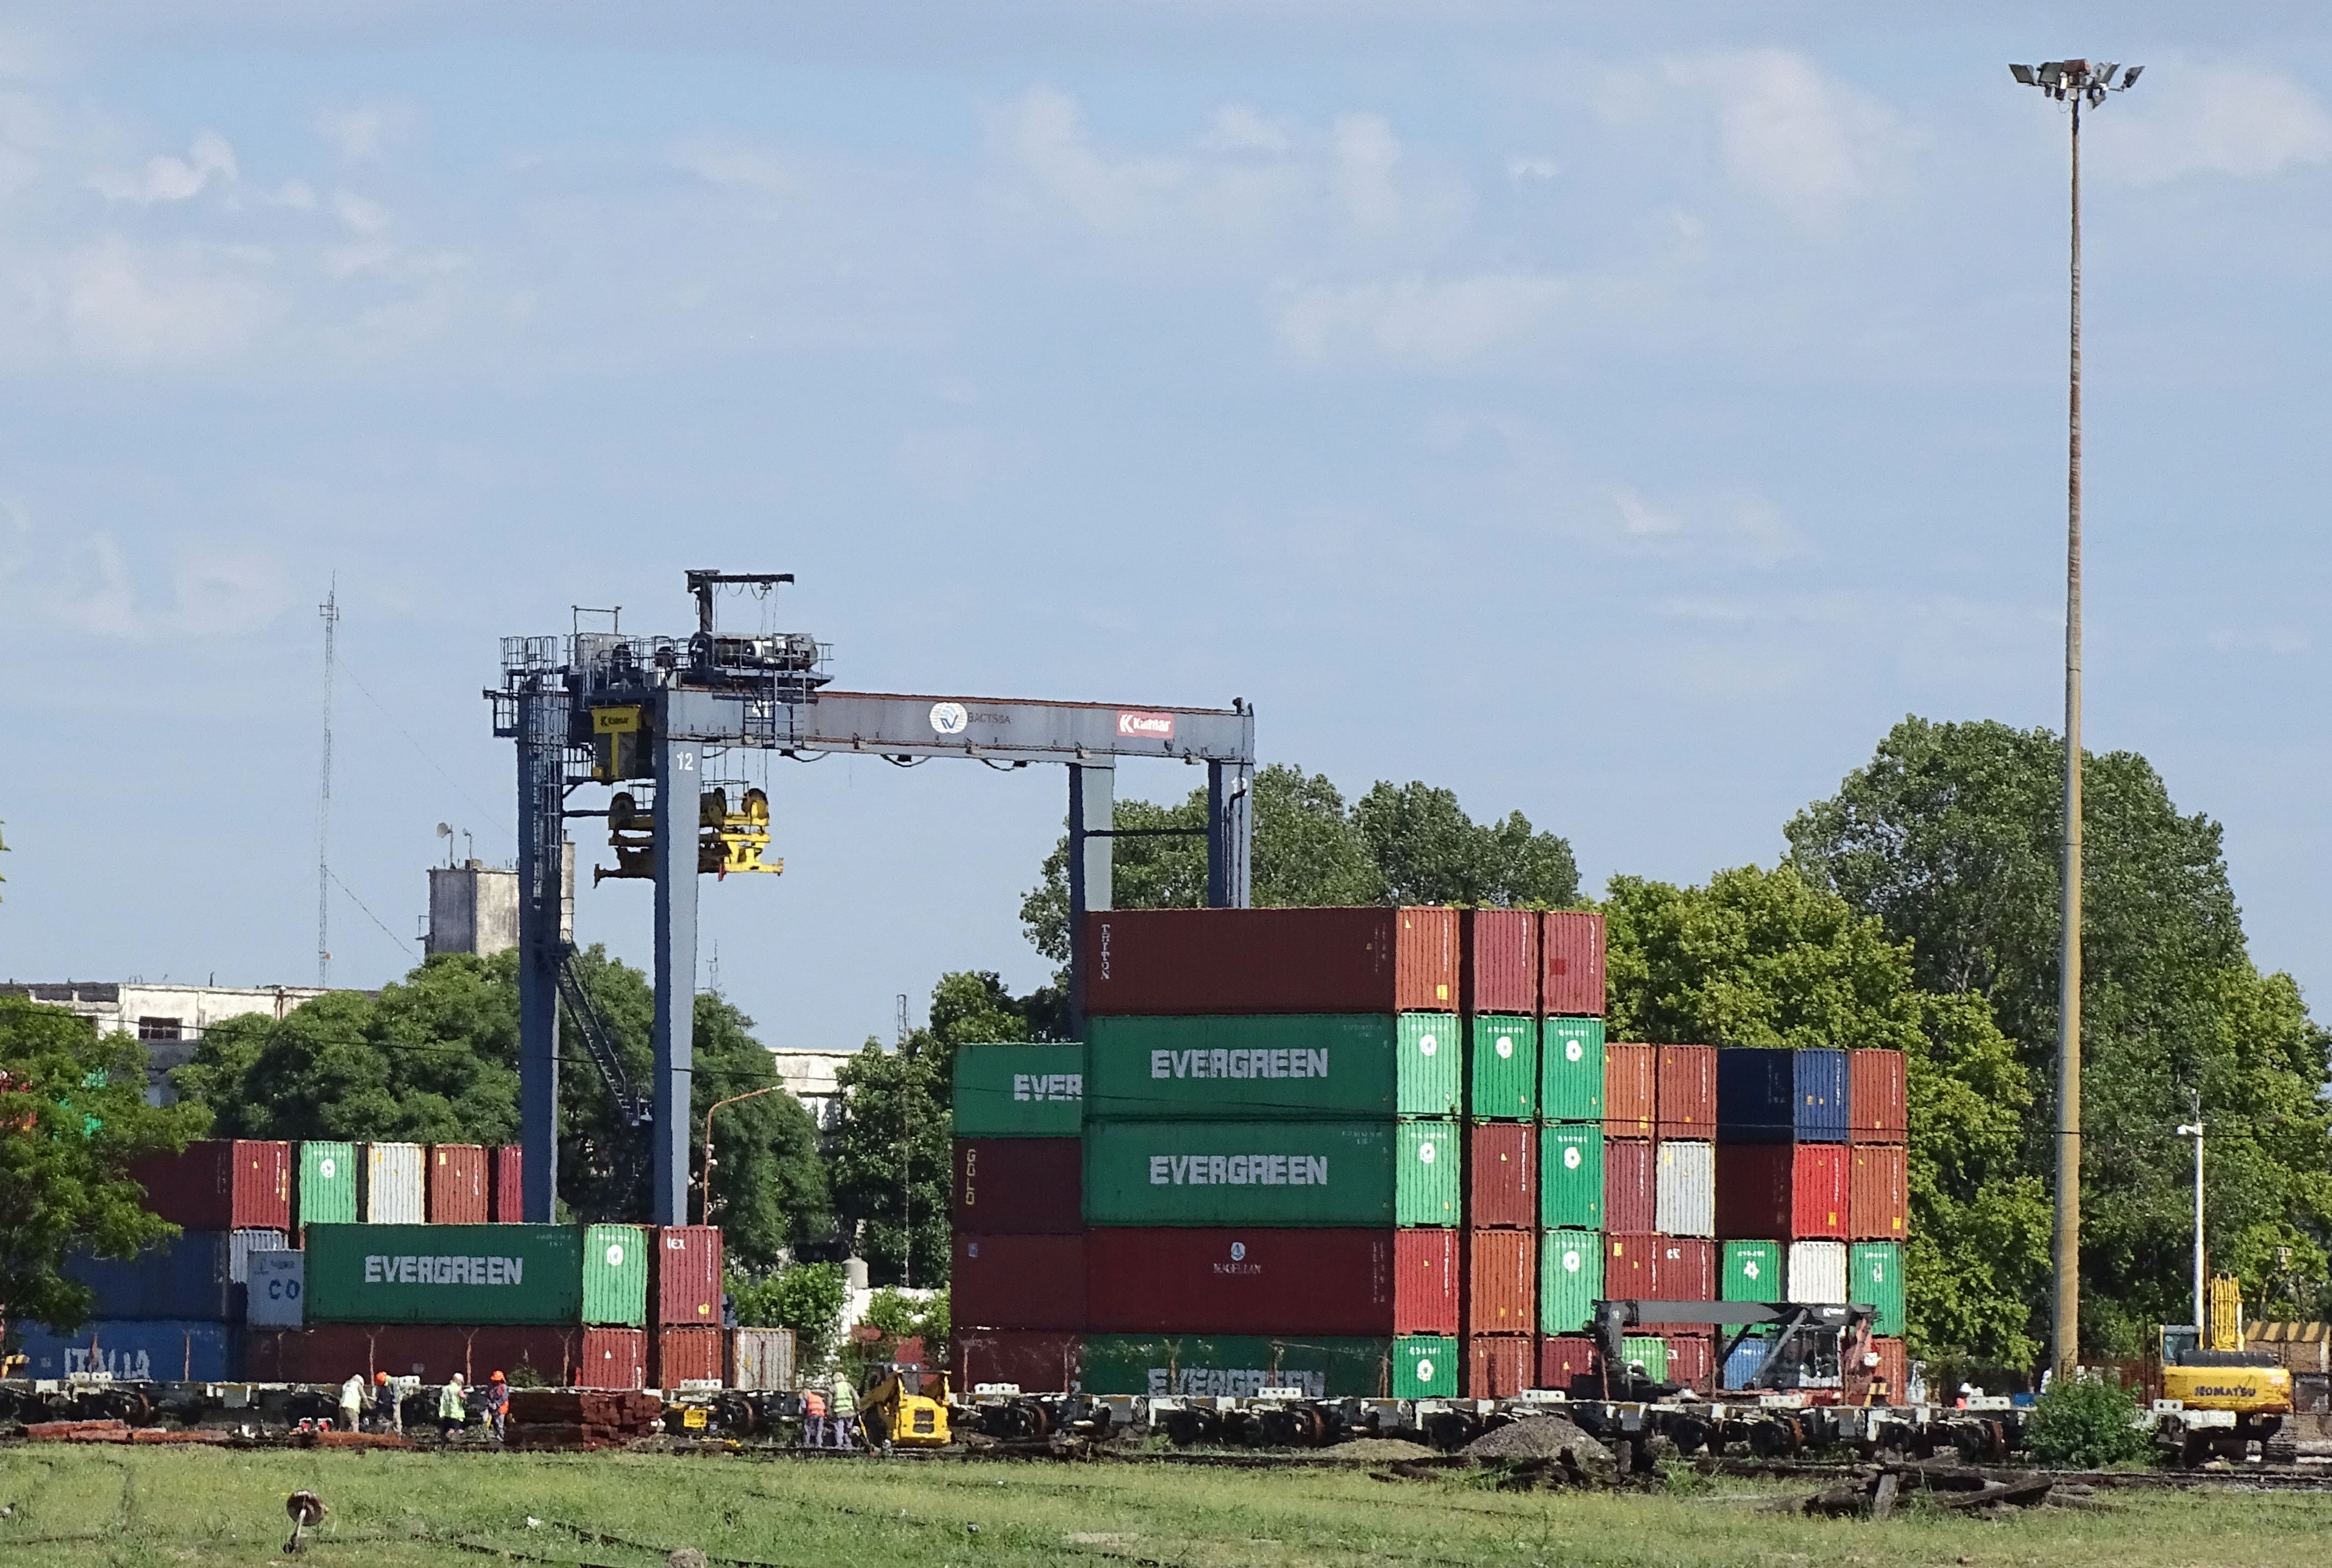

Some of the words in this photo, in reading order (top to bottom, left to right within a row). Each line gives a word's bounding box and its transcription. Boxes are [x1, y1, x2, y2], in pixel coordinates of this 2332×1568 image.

[677, 751, 693, 771] 12
[1101, 924, 1111, 980] TRITON
[1152, 1048, 1328, 1079] EVERGREEN
[1150, 1155, 1328, 1185] EVERGREEN
[365, 1255, 523, 1285] EVERGREEN
[2194, 1384, 2256, 1397] KOMATSU
